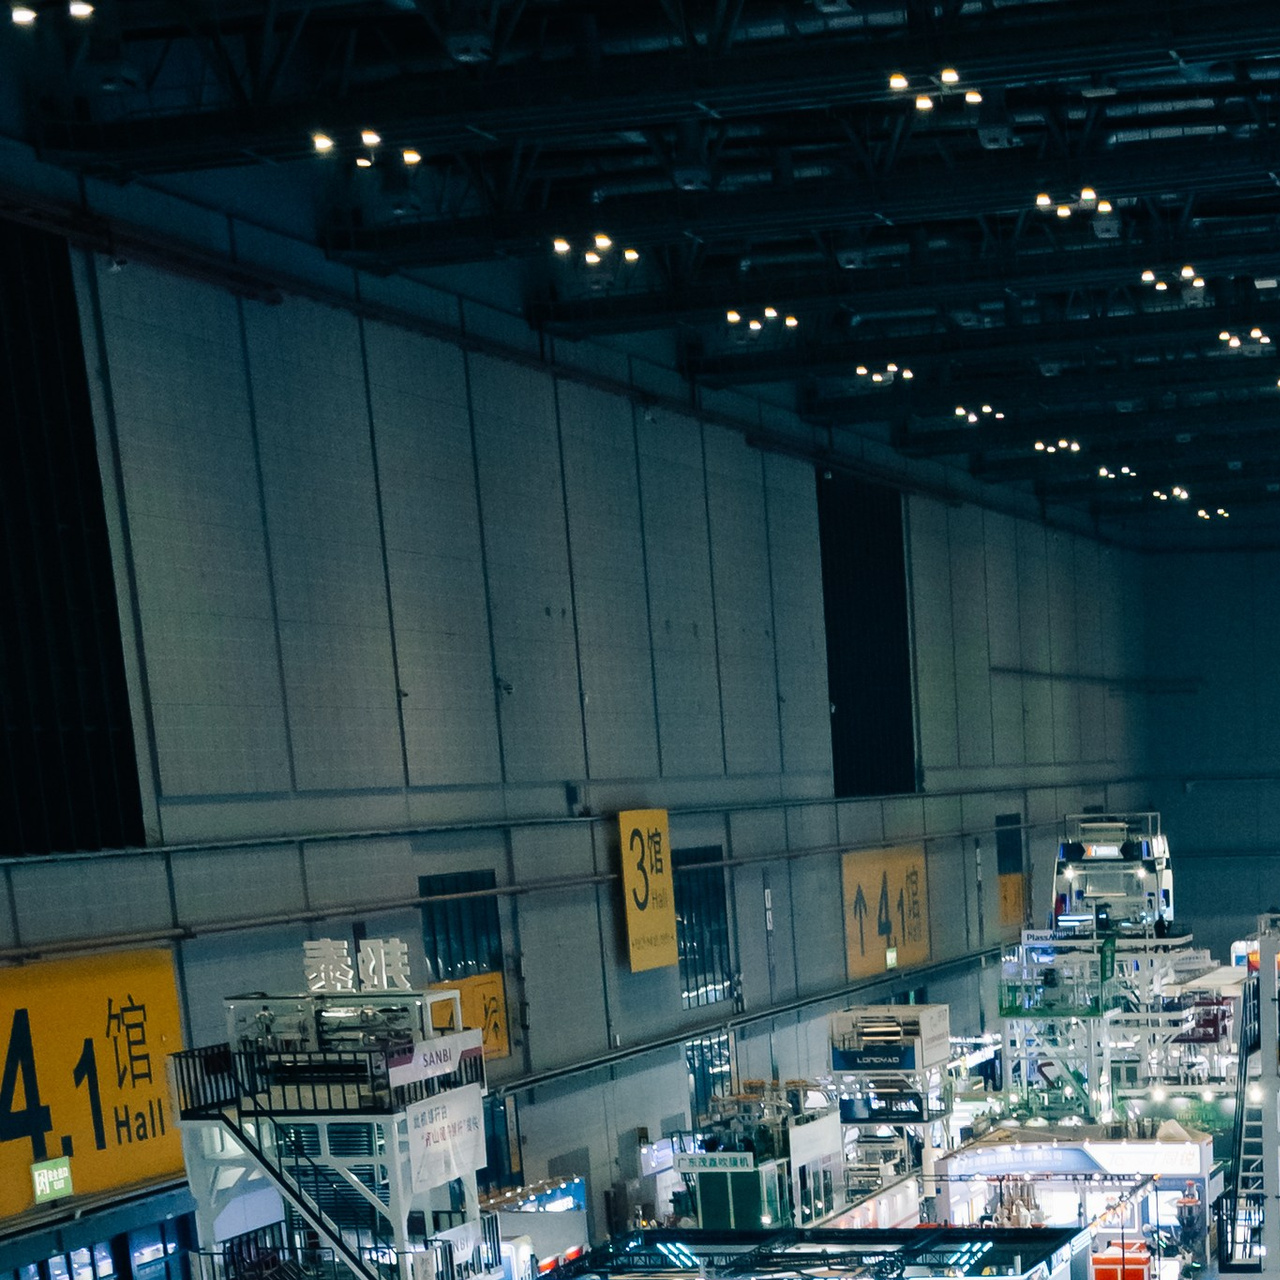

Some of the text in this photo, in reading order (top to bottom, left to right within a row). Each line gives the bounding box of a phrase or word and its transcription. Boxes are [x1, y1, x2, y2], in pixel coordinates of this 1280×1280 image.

[629, 826, 664, 911] 3 馆
[106, 993, 153, 1089] 馆
[423, 1047, 453, 1067] SANBI
[113, 1098, 165, 1146] Hall
